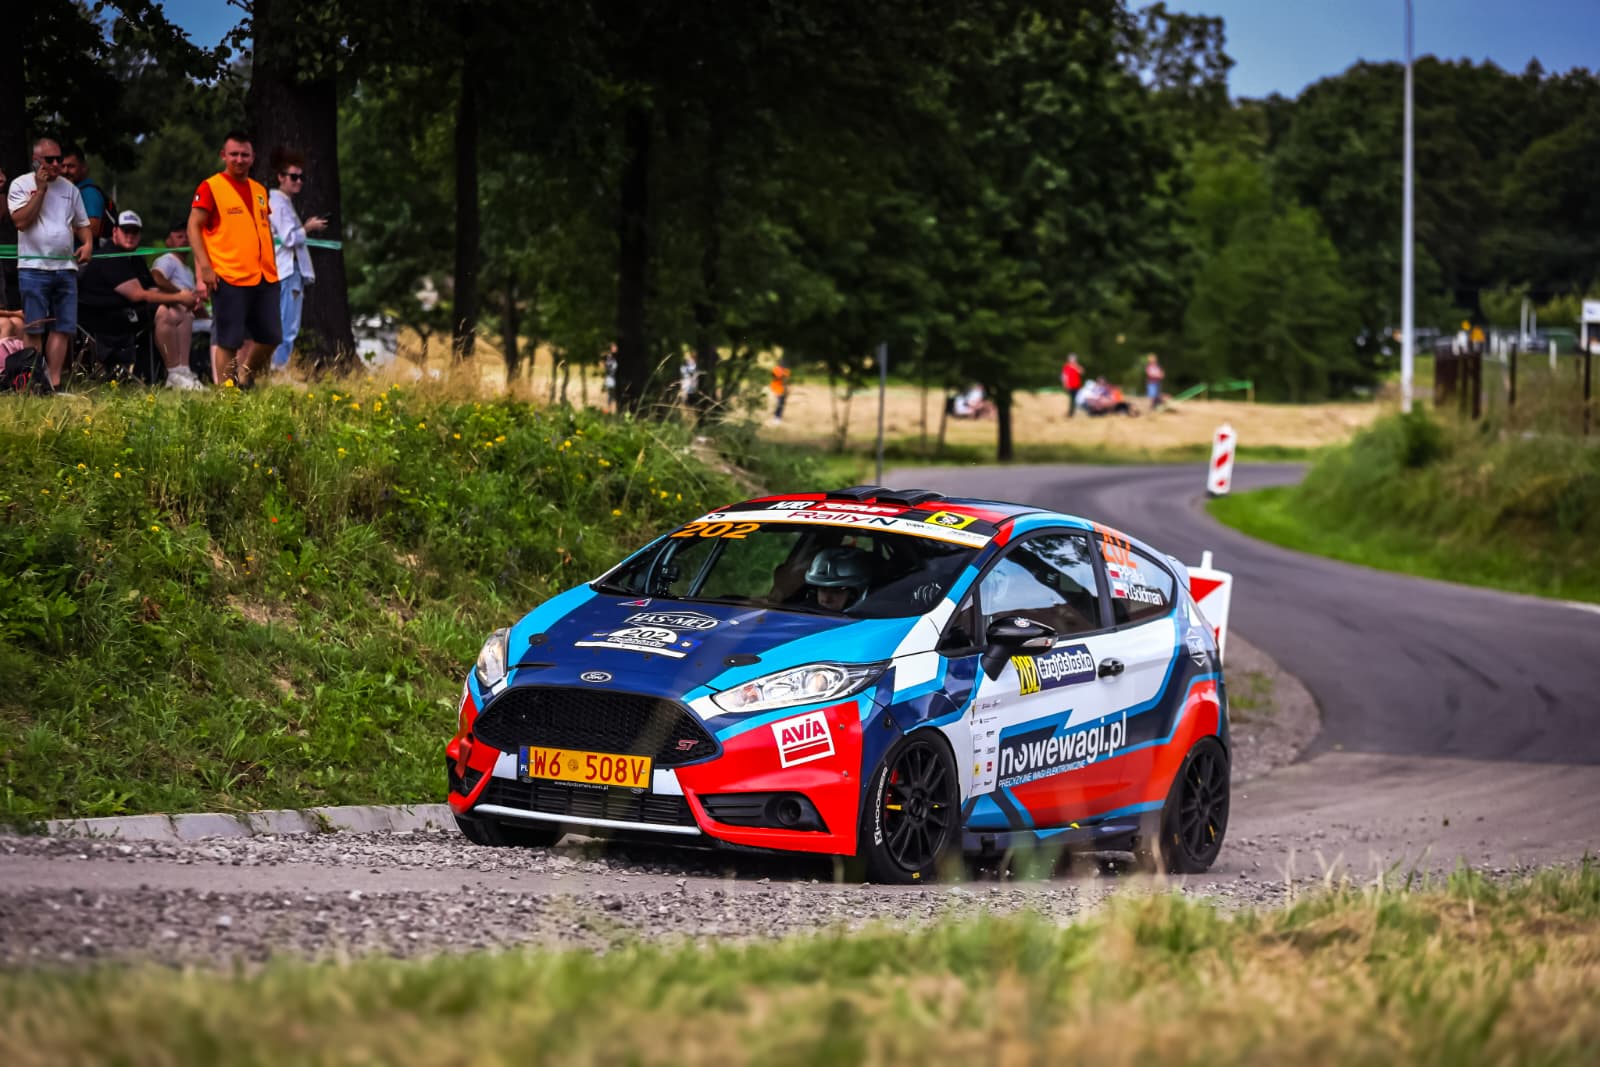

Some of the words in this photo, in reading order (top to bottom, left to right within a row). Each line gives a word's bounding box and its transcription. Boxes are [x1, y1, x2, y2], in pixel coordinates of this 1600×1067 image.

[669, 522, 761, 539] 202
[624, 611, 719, 630] HAS-MED
[624, 629, 670, 640] 202
[1011, 655, 1039, 695] 202
[781, 719, 826, 746] AVIA
[675, 739, 698, 751] ST
[1000, 711, 1127, 777] nowewagi.pl
[520, 764, 529, 772] PL
[534, 749, 561, 777] W6
[584, 755, 645, 785] 508V
